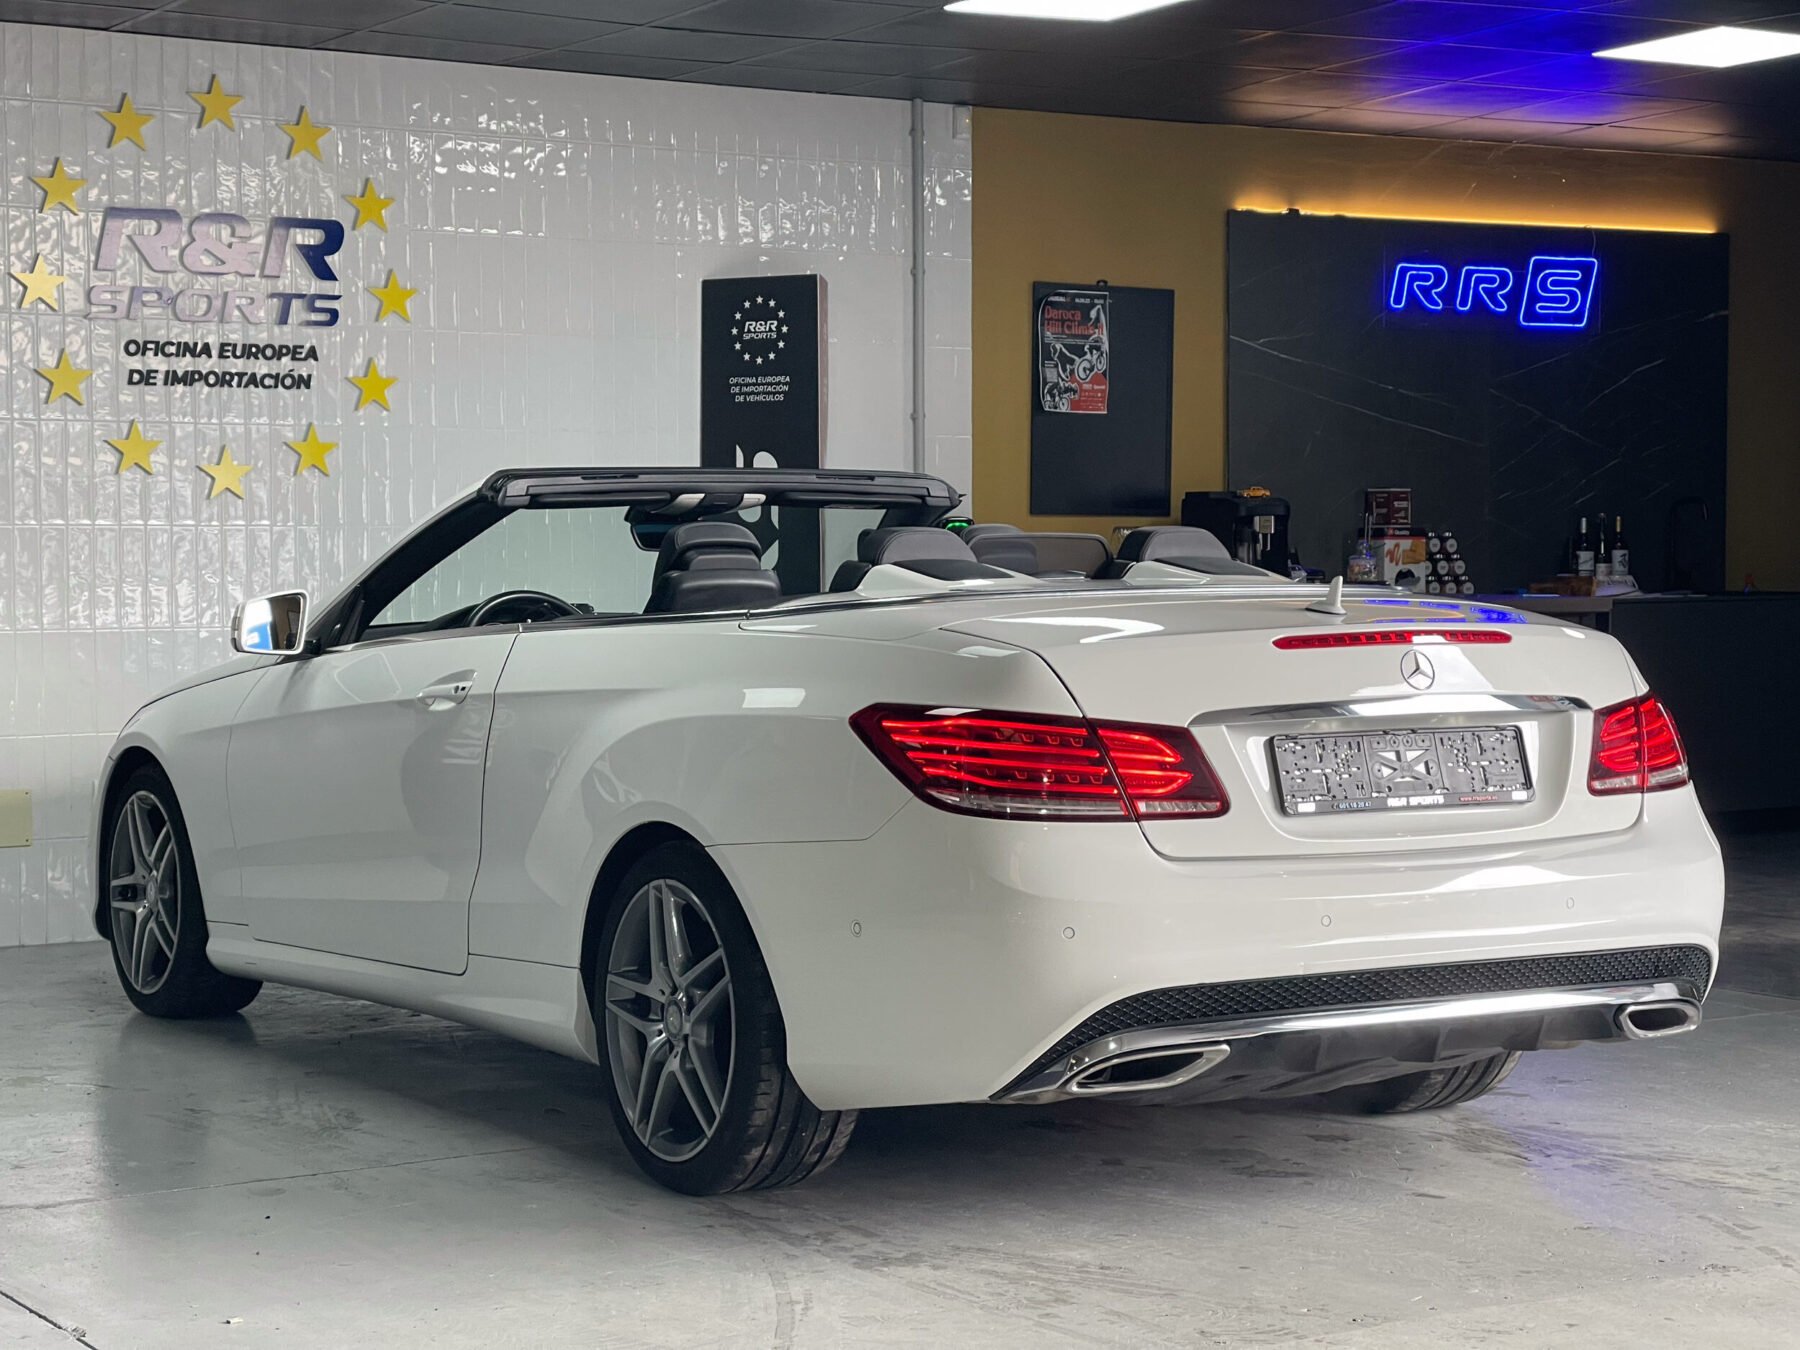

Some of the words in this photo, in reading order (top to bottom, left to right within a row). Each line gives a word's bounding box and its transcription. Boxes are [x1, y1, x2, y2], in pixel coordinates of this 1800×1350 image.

[94, 206, 345, 281] R&R
[1390, 262, 1583, 314] RRS
[85, 285, 343, 327] SPORTS
[1044, 305, 1082, 320] Daroca
[744, 320, 778, 332] R&R
[1044, 320, 1062, 335] Hill
[743, 332, 777, 340] SPORTS
[123, 339, 213, 360] OFICINA
[217, 342, 319, 362] EUROPEA
[127, 368, 159, 386] DE
[163, 369, 312, 390] IMPORTACIÓN
[729, 377, 757, 385] OFICINA
[757, 376, 791, 384] EUROPEA
[741, 384, 789, 393] IMPORTACIÓN
[746, 394, 785, 402] VEHÍCULOS
[1387, 797, 1407, 807] R&R
[1409, 795, 1445, 806] SPORTS
